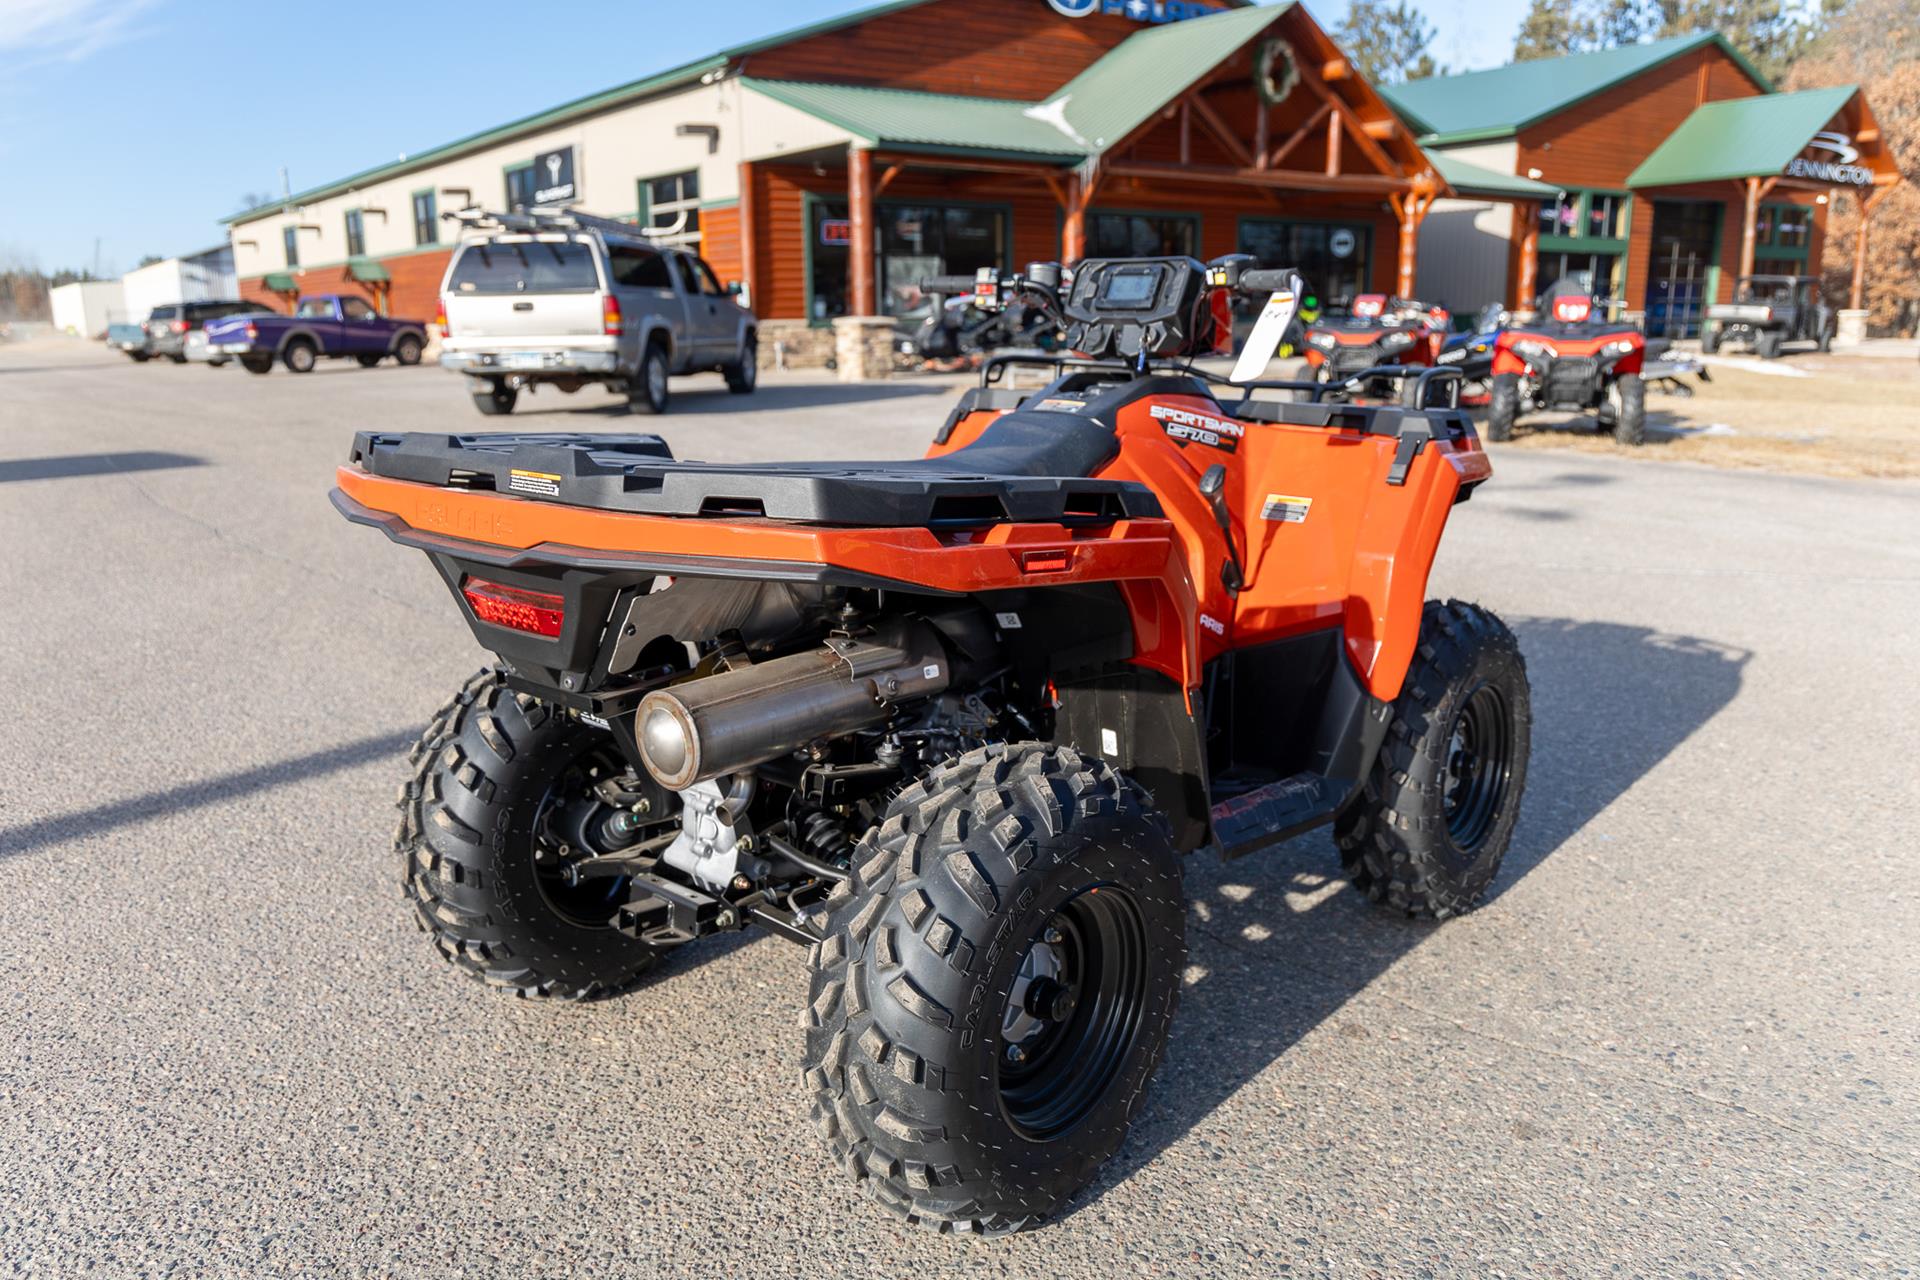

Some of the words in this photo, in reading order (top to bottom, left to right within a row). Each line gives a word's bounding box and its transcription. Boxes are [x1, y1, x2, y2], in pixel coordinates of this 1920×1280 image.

[1150, 405, 1245, 437] SPORTSMAN
[1167, 422, 1219, 446] 570
[960, 887, 1034, 1050] CARLSTAR
